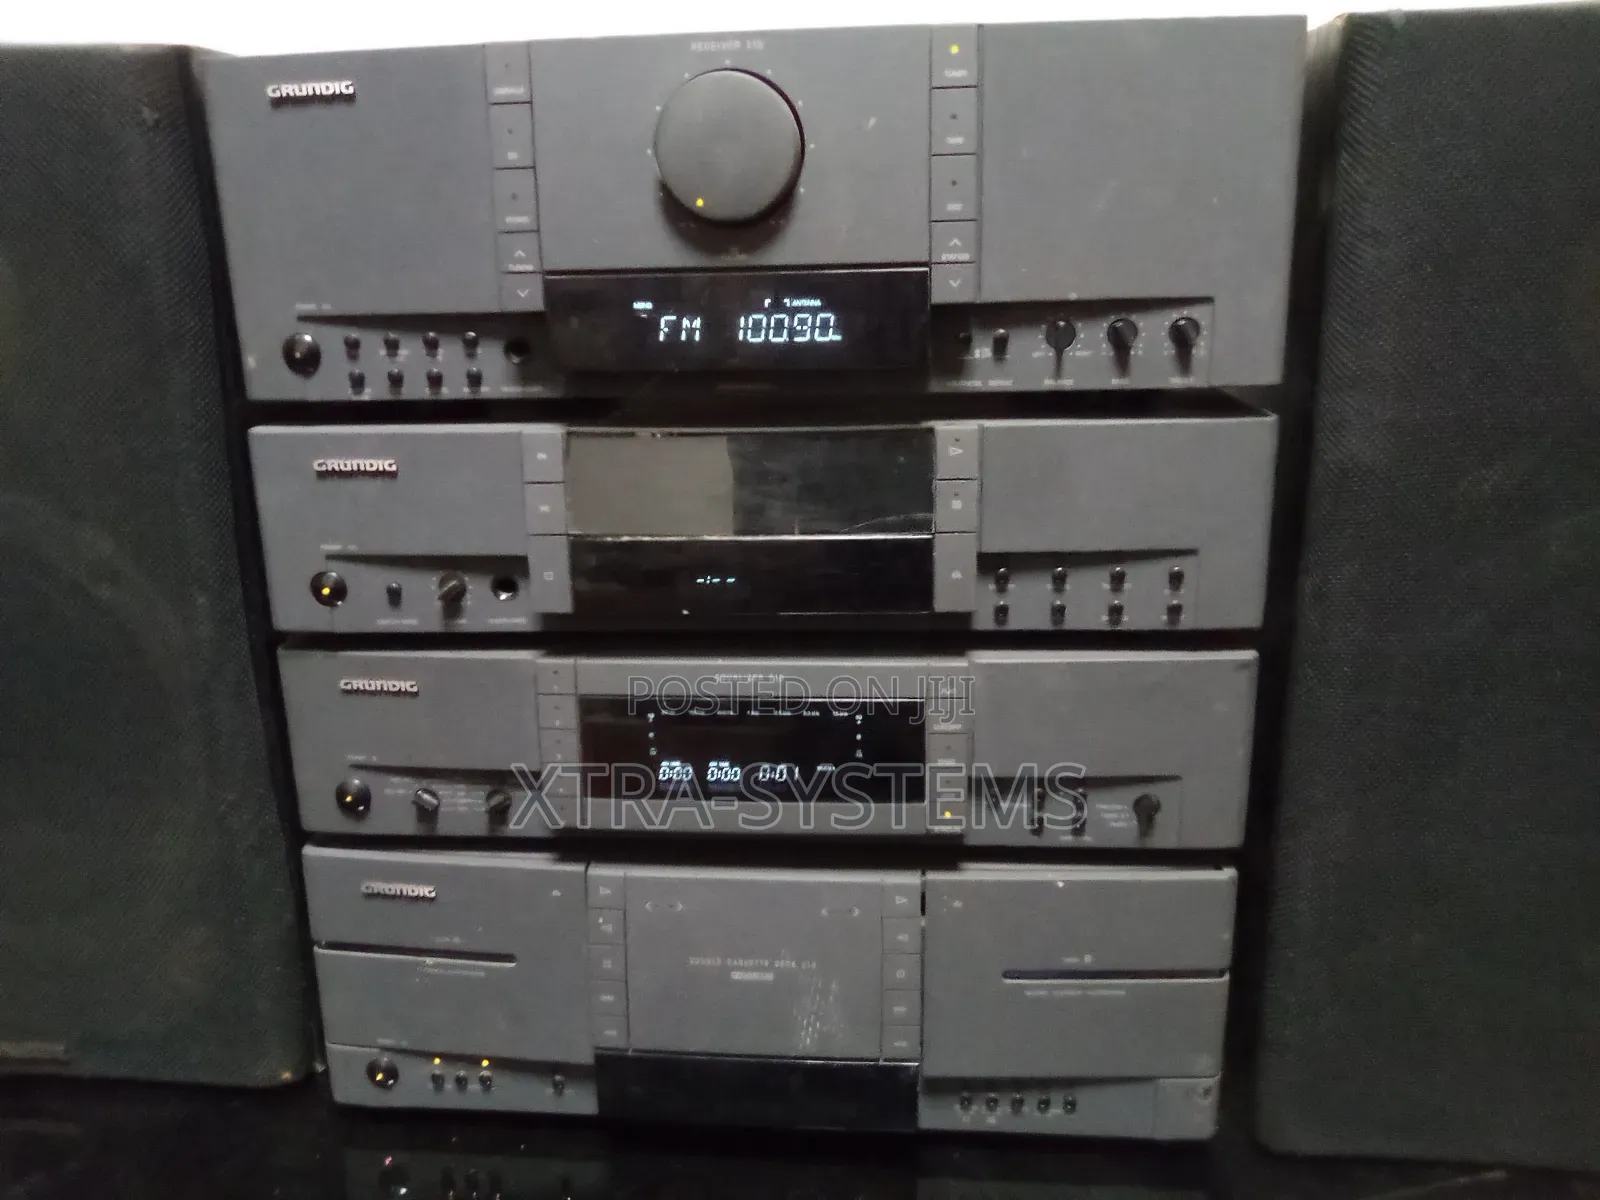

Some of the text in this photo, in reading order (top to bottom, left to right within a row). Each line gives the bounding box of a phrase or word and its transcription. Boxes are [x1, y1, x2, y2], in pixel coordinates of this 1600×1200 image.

[267, 80, 356, 98] GRUNDIG
[658, 314, 702, 342] FM
[312, 458, 398, 473] GRUNDIG
[338, 678, 419, 693] GRUNDIG
[360, 882, 437, 899] GRUNDIG
